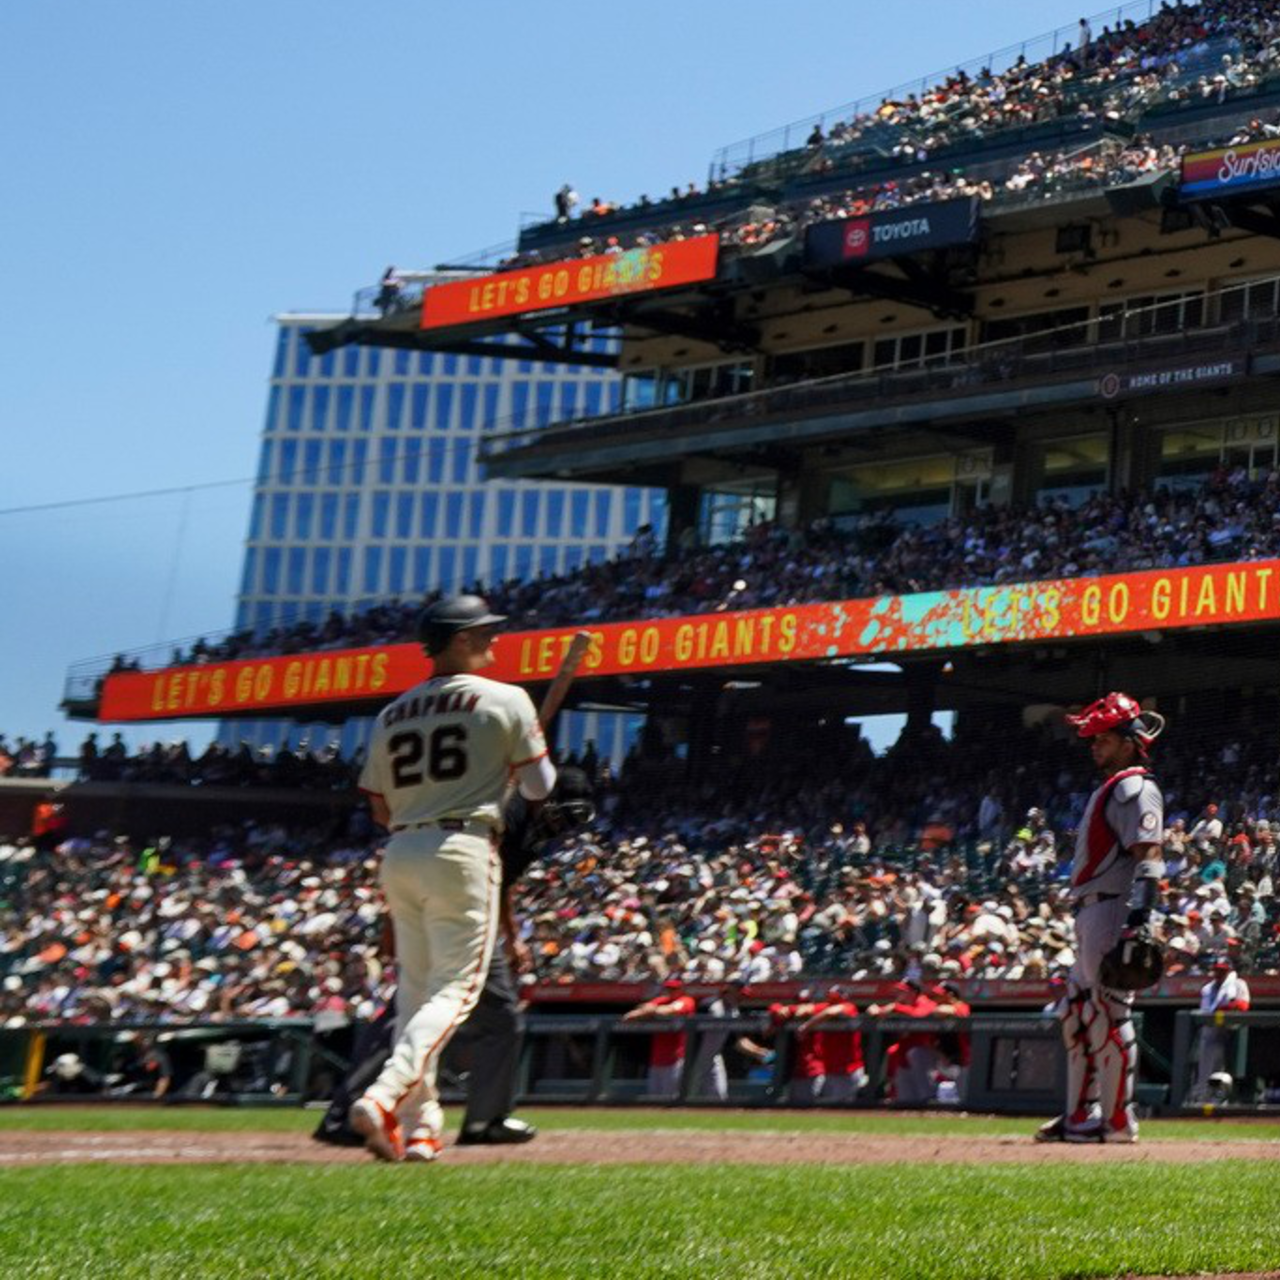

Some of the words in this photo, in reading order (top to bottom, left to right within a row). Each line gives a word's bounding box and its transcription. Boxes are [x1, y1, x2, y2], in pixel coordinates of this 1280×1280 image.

[872, 218, 931, 242] TOYOTA
[468, 277, 530, 313] LET'S
[538, 269, 570, 300] GO
[960, 588, 1062, 637] LET'S
[1081, 582, 1130, 626] GO
[617, 626, 660, 666] GO
[674, 613, 798, 662] GIANTS
[151, 669, 225, 712] LET'S
[235, 663, 274, 702] GO
[282, 652, 391, 699] GIANTS
[383, 692, 482, 728] CHAPMAN
[388, 723, 468, 790] 26
